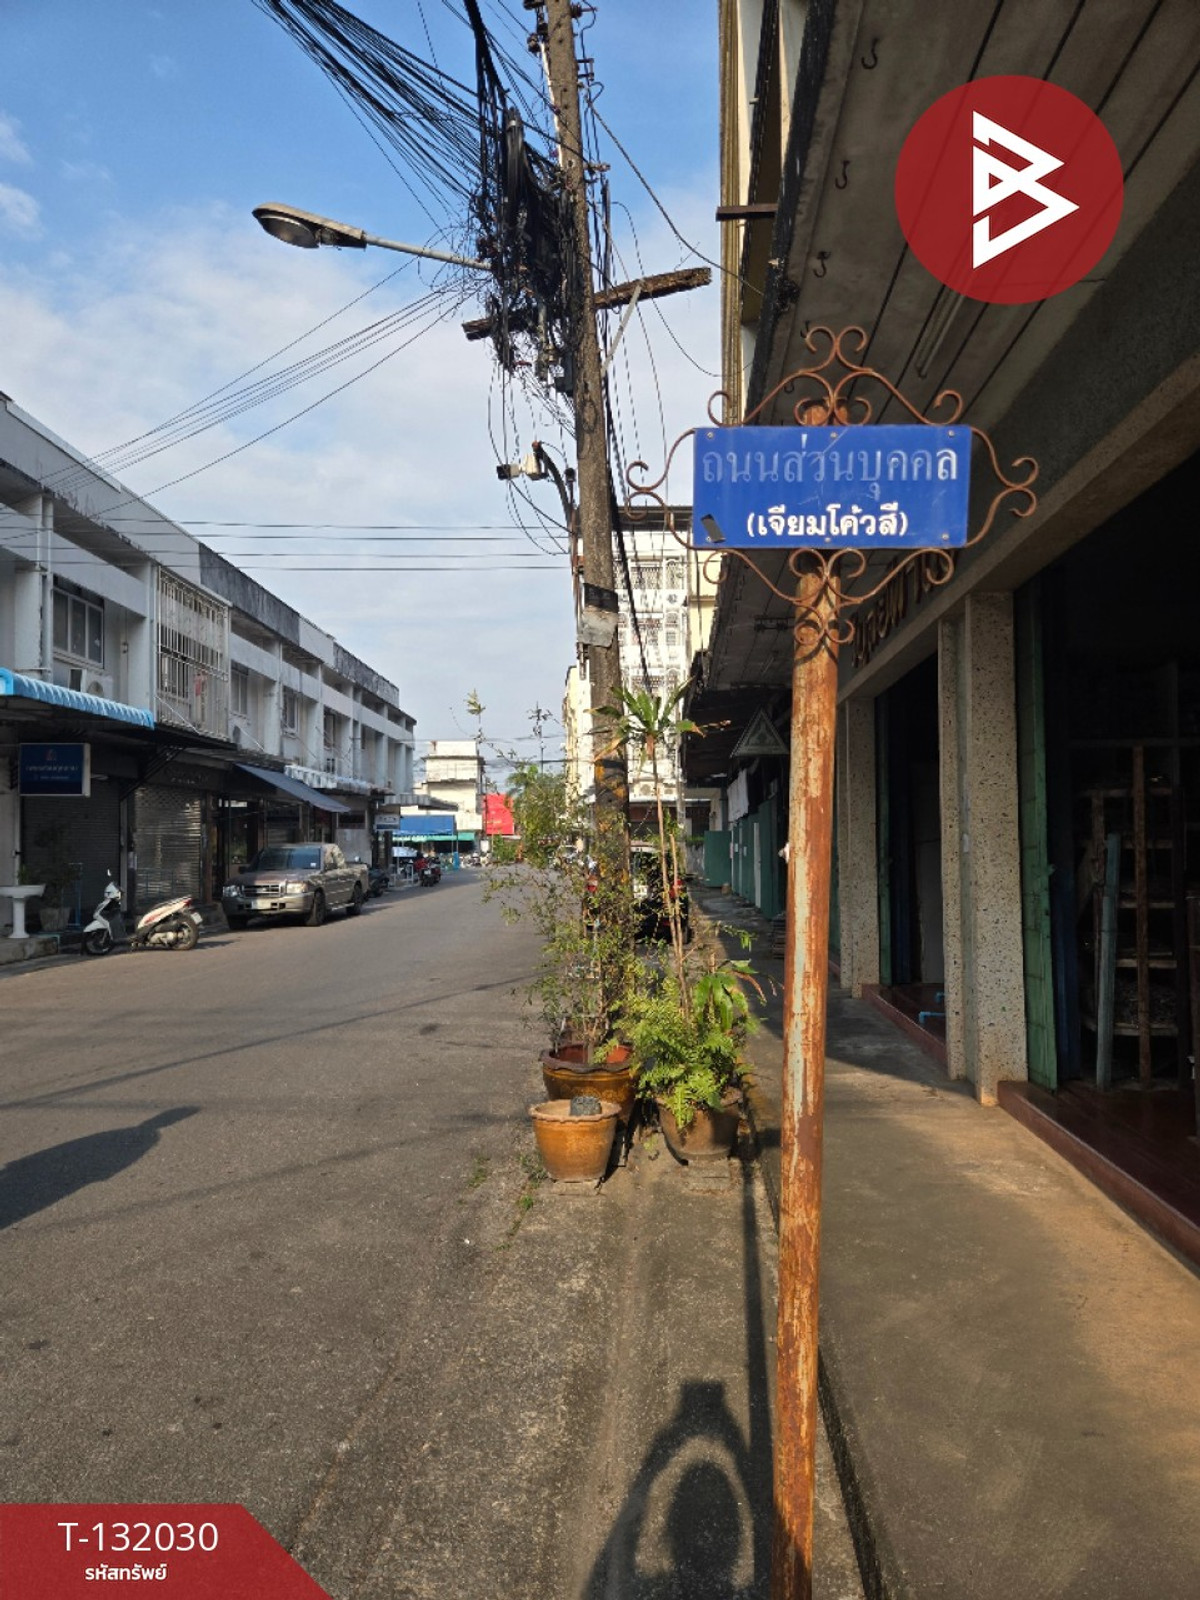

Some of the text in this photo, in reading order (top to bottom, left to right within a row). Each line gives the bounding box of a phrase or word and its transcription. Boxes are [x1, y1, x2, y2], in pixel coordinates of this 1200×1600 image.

[702, 433, 958, 500] ถนนส่วนบุคคล
[747, 501, 909, 537] (เจียมโค้วสี)
